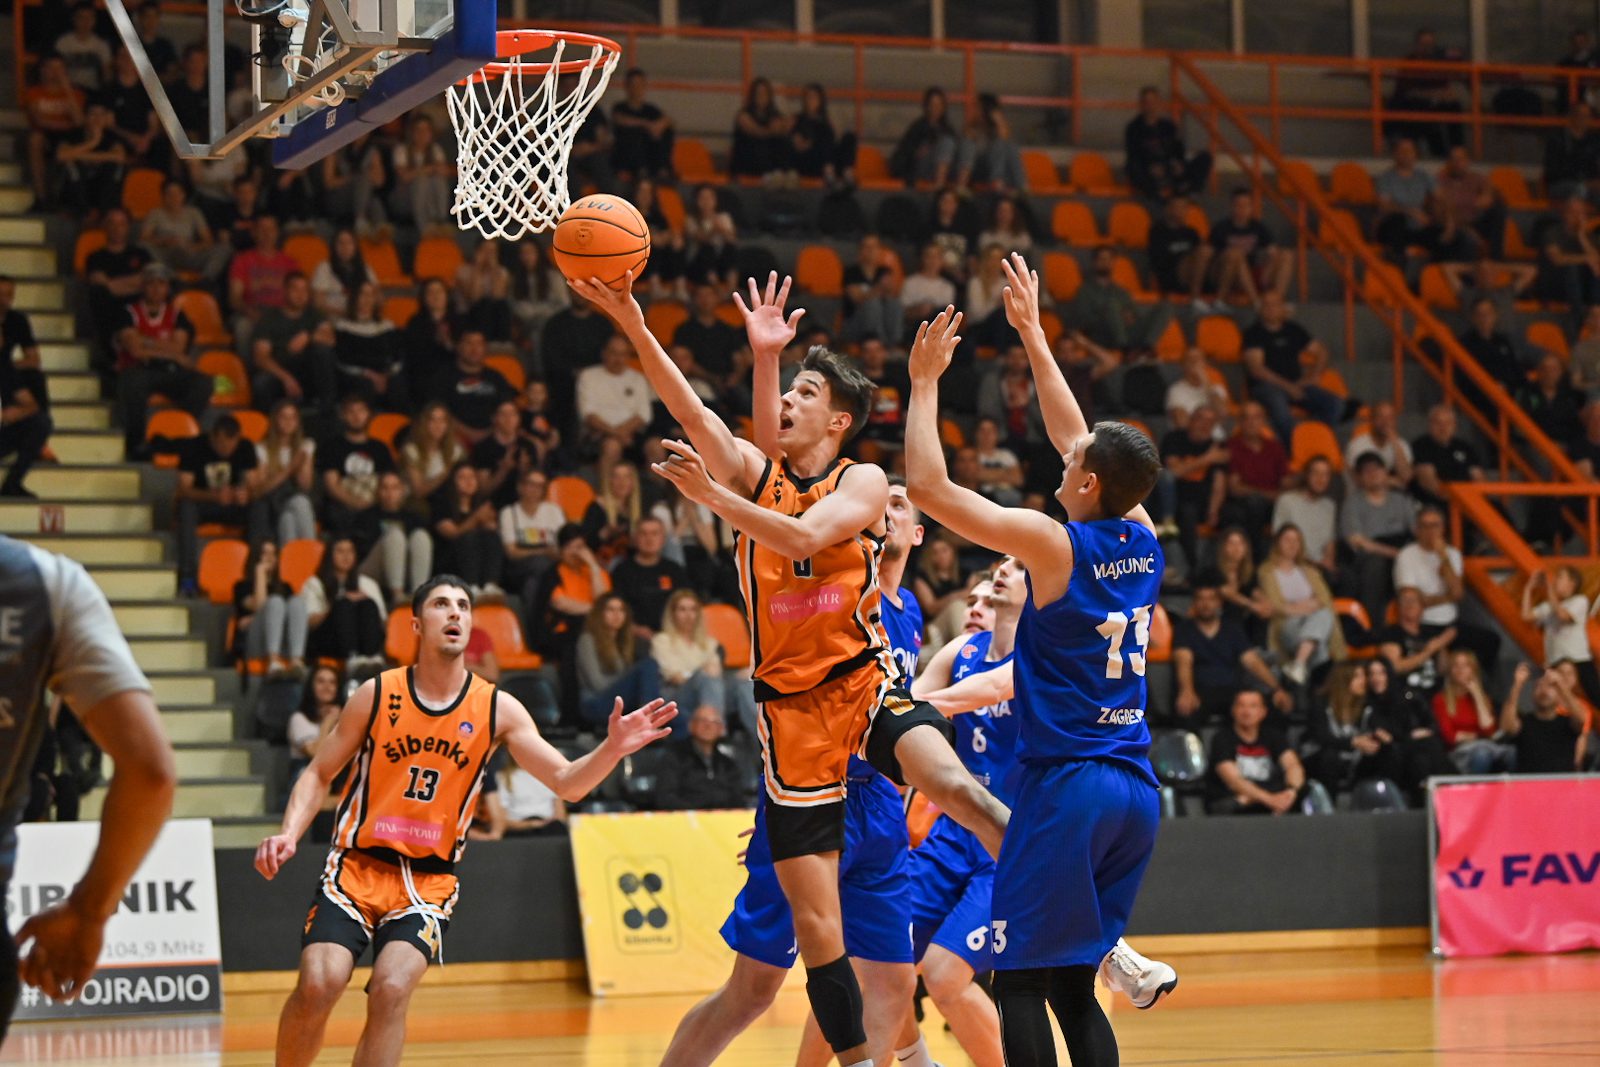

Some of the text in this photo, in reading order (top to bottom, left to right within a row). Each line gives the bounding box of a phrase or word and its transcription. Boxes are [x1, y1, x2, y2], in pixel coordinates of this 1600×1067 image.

[803, 593, 841, 610] POWR
[1095, 603, 1153, 680] 13
[972, 726, 988, 754] 6
[403, 765, 441, 802] 13
[374, 821, 398, 834] PINK
[408, 825, 442, 841] POWE
[1502, 851, 1600, 887] FAV
[6, 878, 196, 917] IBNIK
[966, 925, 989, 952] 6
[990, 920, 1008, 955] 3
[21, 973, 211, 1007] #OJRADIO
